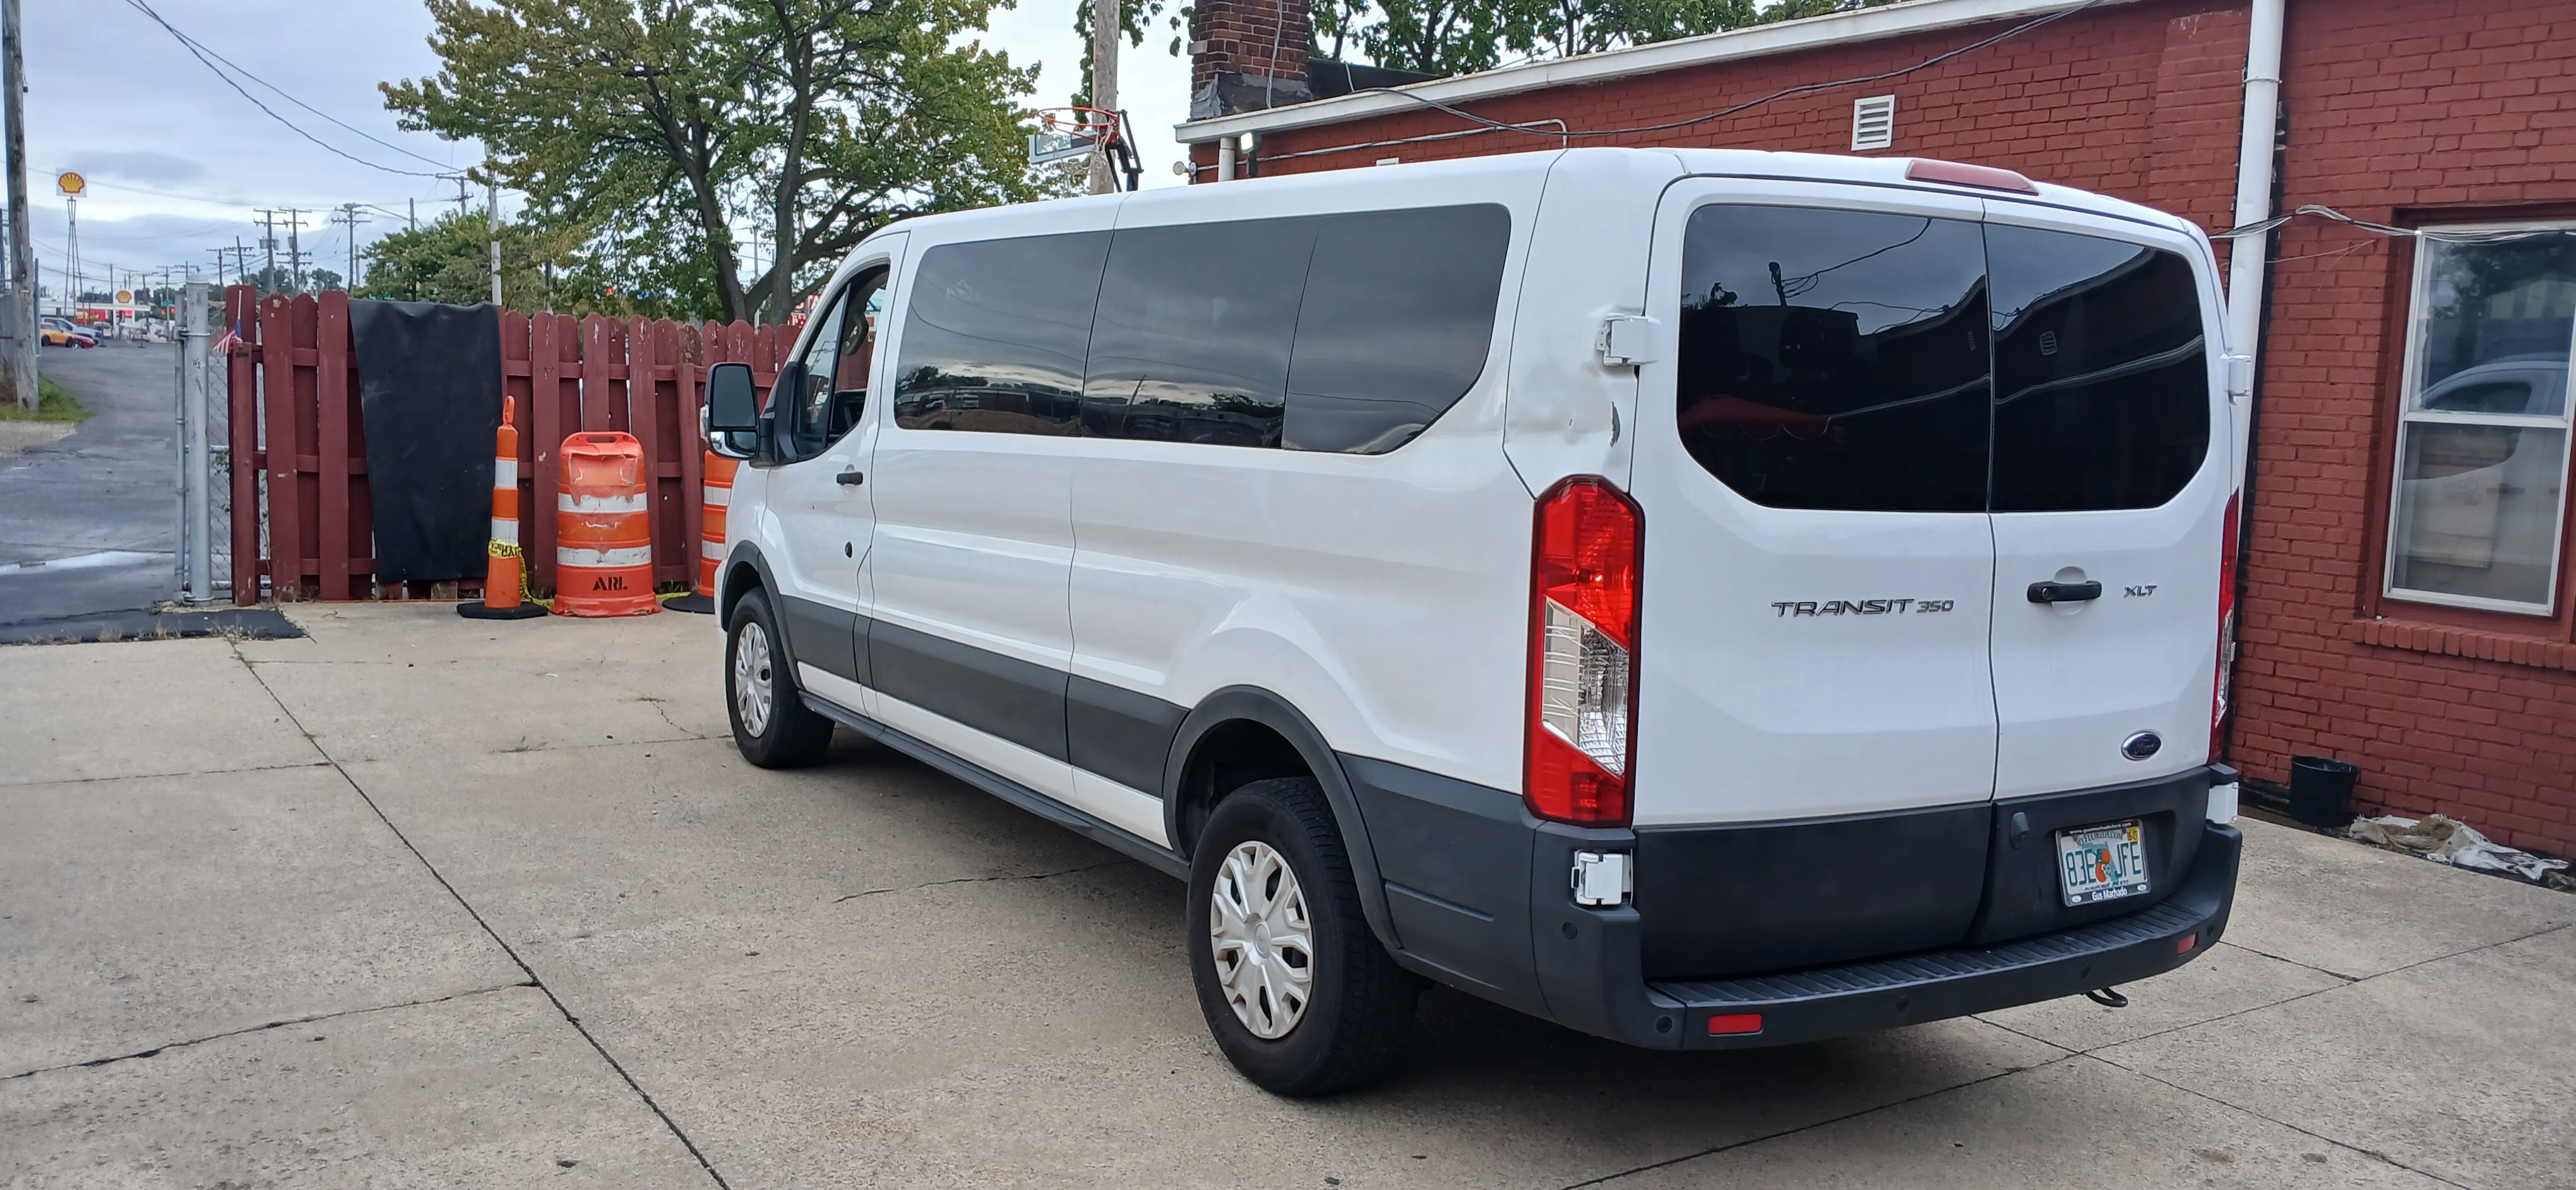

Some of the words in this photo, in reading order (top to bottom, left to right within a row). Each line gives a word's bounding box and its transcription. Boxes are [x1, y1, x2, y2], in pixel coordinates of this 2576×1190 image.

[593, 576, 628, 591] ARL
[2123, 585, 2158, 598] XLT
[1772, 599, 1914, 617] TRANSIT
[1916, 600, 1954, 613] 350
[2065, 848, 2097, 886] 83E
[2114, 841, 2142, 879] JFE
